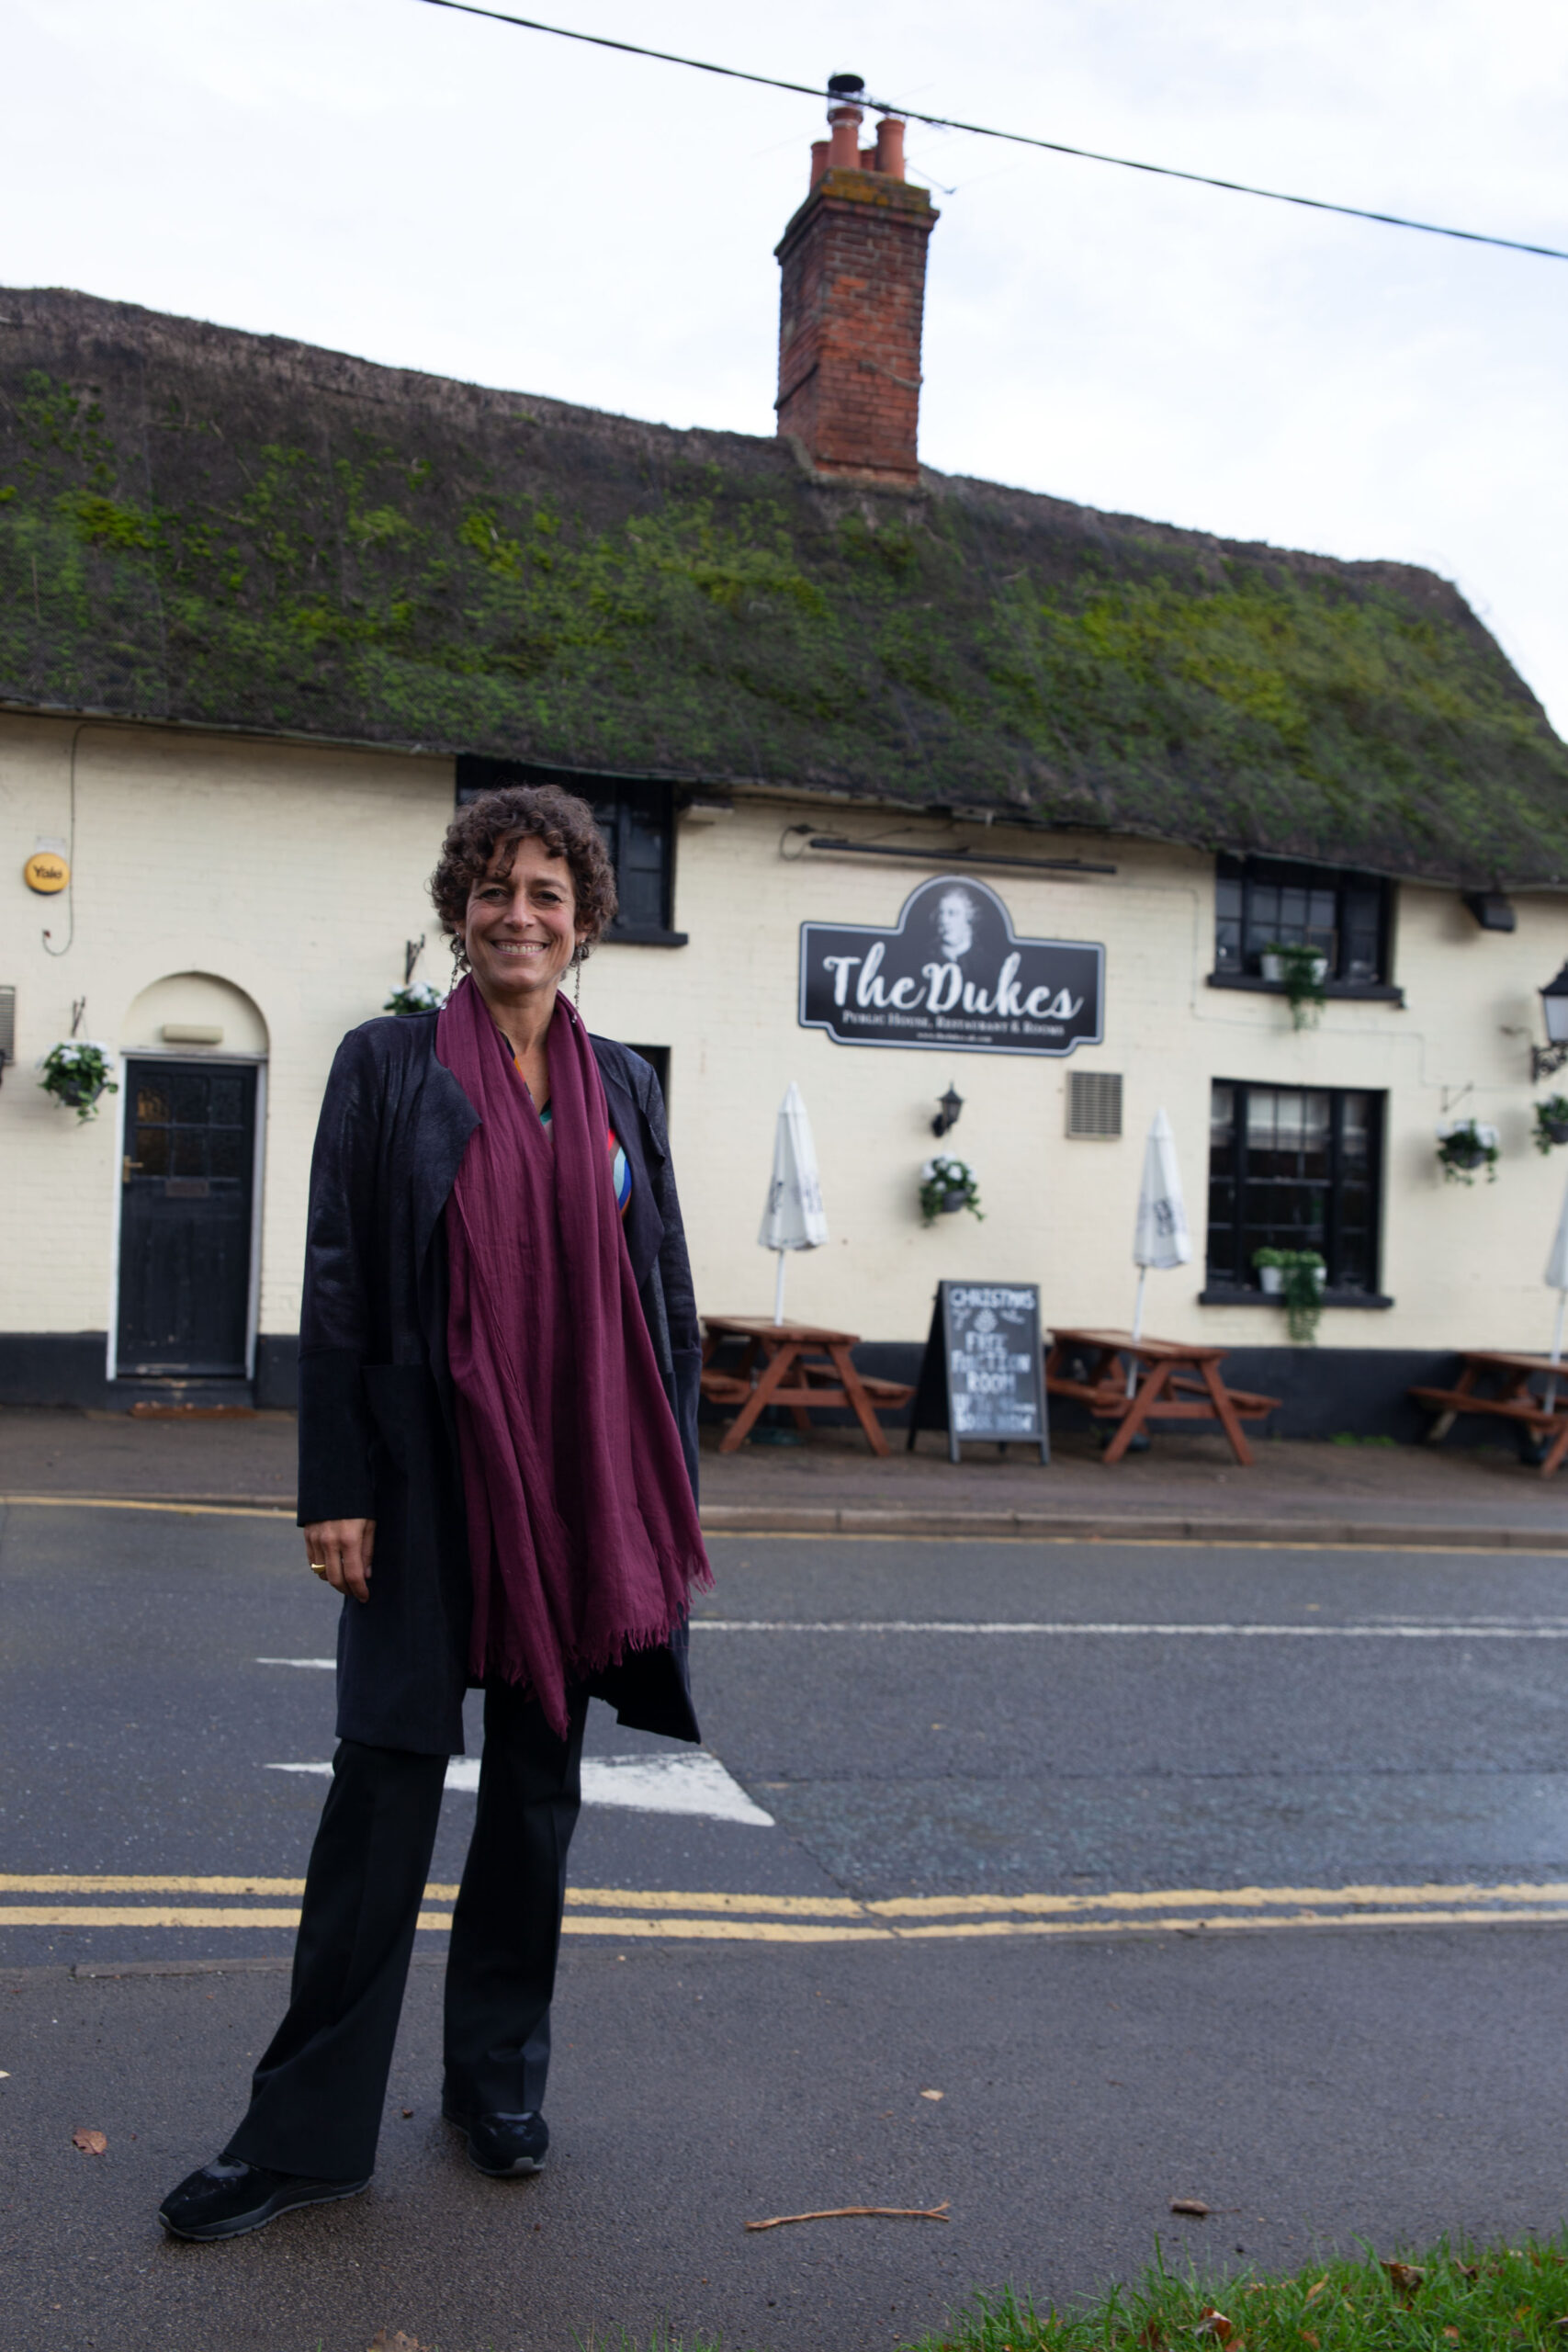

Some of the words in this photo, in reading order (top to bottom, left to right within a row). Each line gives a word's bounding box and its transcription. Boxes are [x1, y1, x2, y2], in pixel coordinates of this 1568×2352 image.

[33, 865, 62, 879] Yale
[823, 942, 925, 1010] The
[921, 952, 1084, 1020] Dukes
[950, 1287, 1035, 1309] CHRISTMAS
